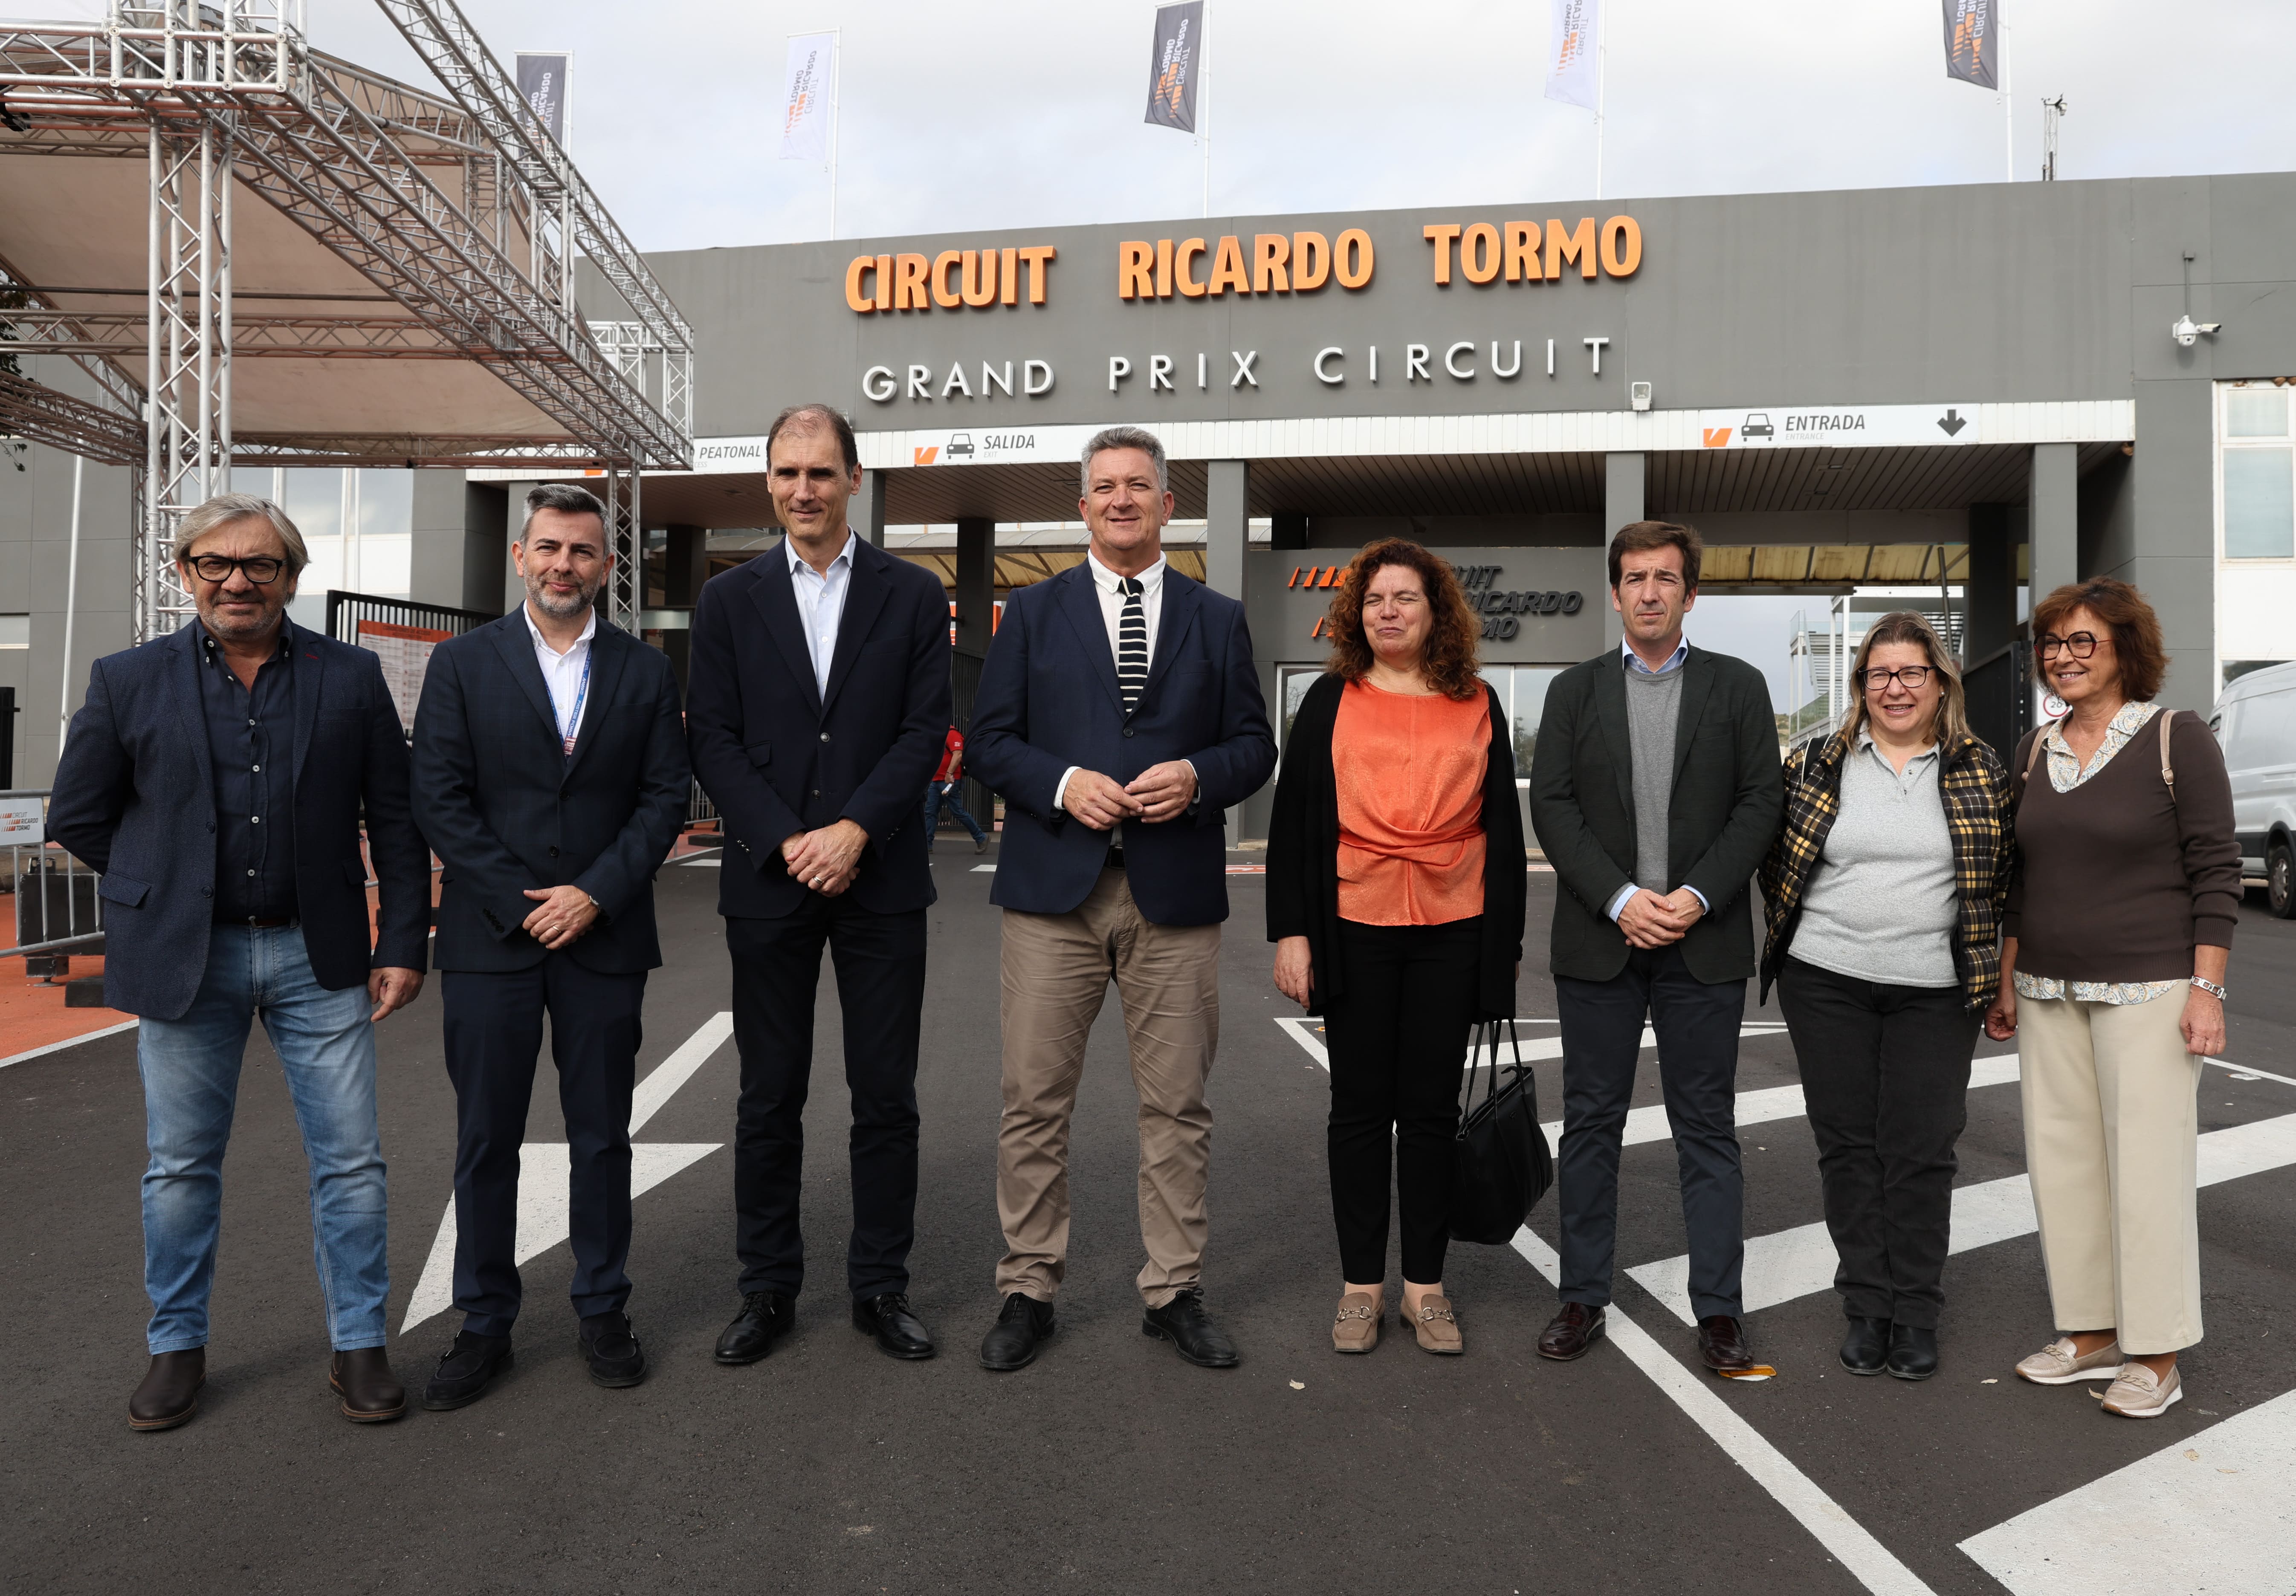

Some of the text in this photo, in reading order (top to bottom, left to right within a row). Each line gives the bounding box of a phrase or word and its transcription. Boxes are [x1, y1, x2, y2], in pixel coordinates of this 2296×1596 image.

[845, 215, 1642, 313] CIRCUIT RICARDO TORMO
[862, 337, 1610, 402] GRAND PRIX CIRCUIT
[1786, 414, 1865, 431] ENTRADA
[984, 435, 1035, 449] SALIDA
[1785, 432, 1824, 440] ENTRANCE
[699, 445, 761, 459] PEATONAL
[573, 700, 581, 719] FASTER
